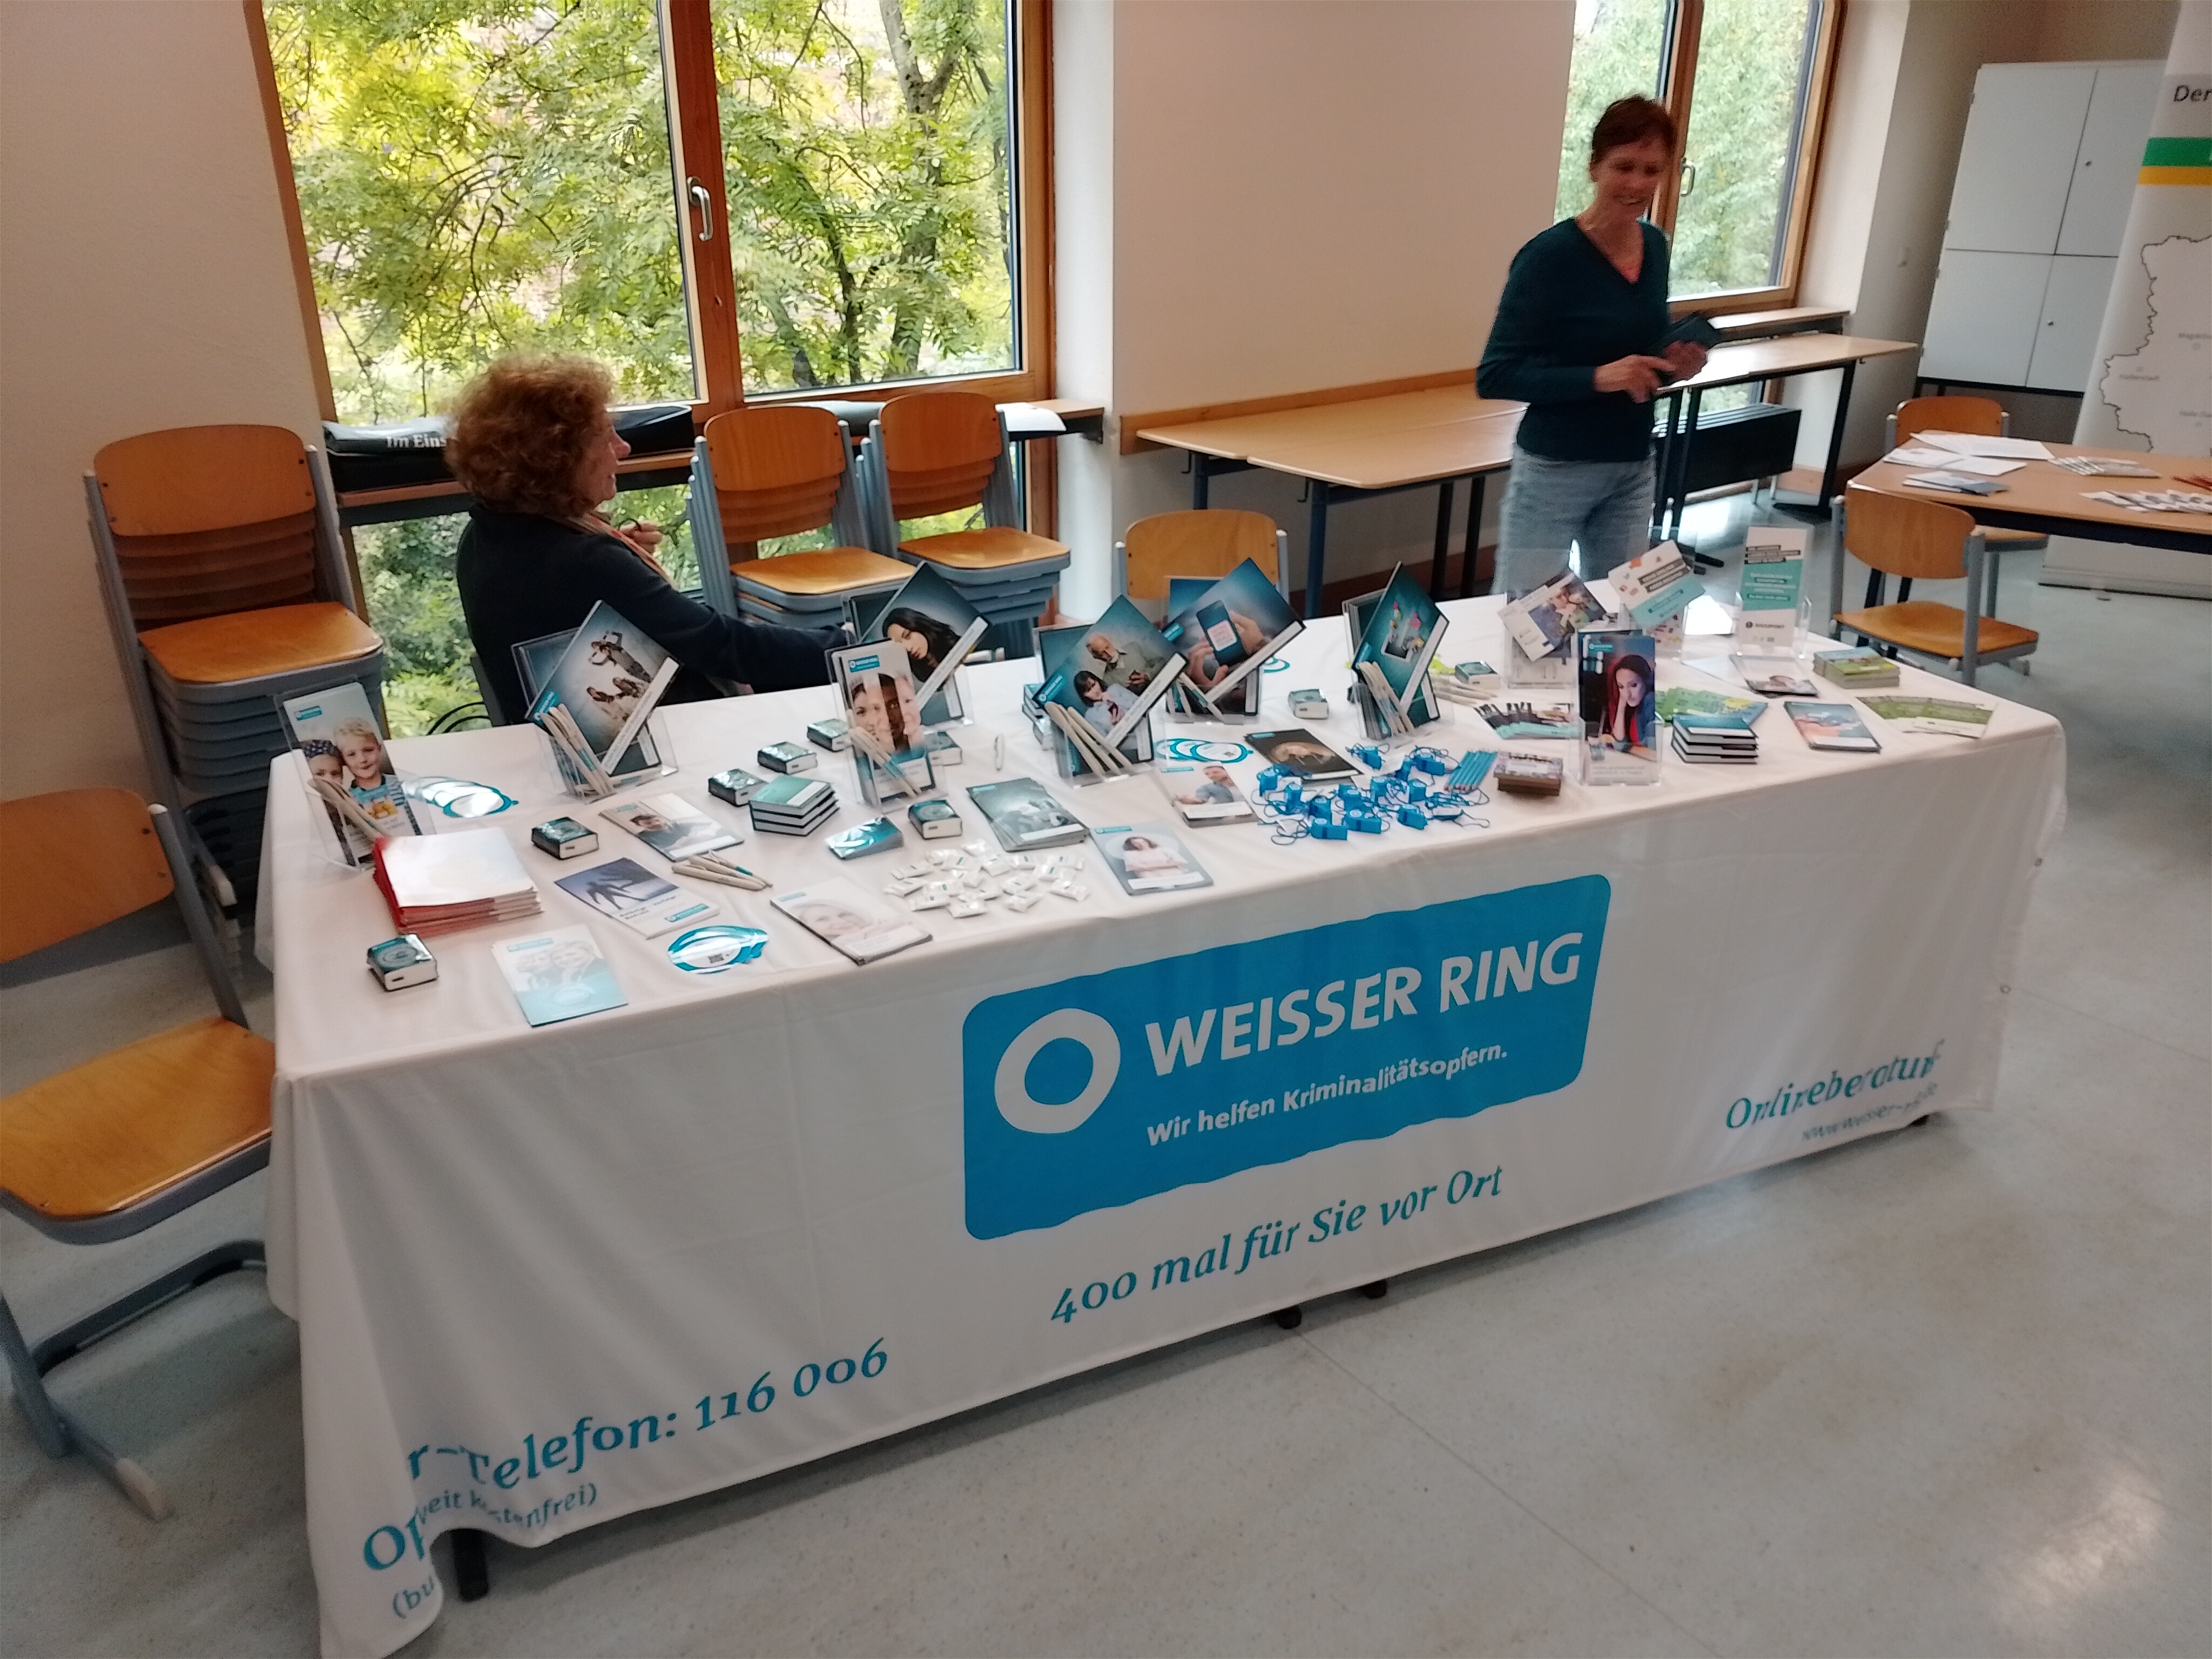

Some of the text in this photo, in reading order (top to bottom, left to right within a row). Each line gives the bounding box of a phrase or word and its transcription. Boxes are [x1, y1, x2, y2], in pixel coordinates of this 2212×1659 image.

[386, 435, 409, 448] Im
[1146, 933, 1582, 1075] WEISSER RING
[1148, 1044, 1508, 1147] Wir helfen Kriminalitätsopfern.
[1051, 1165, 1503, 1324] 400 mal für Sie vor Ort
[696, 1372, 776, 1431] 116
[792, 1338, 888, 1398] 006
